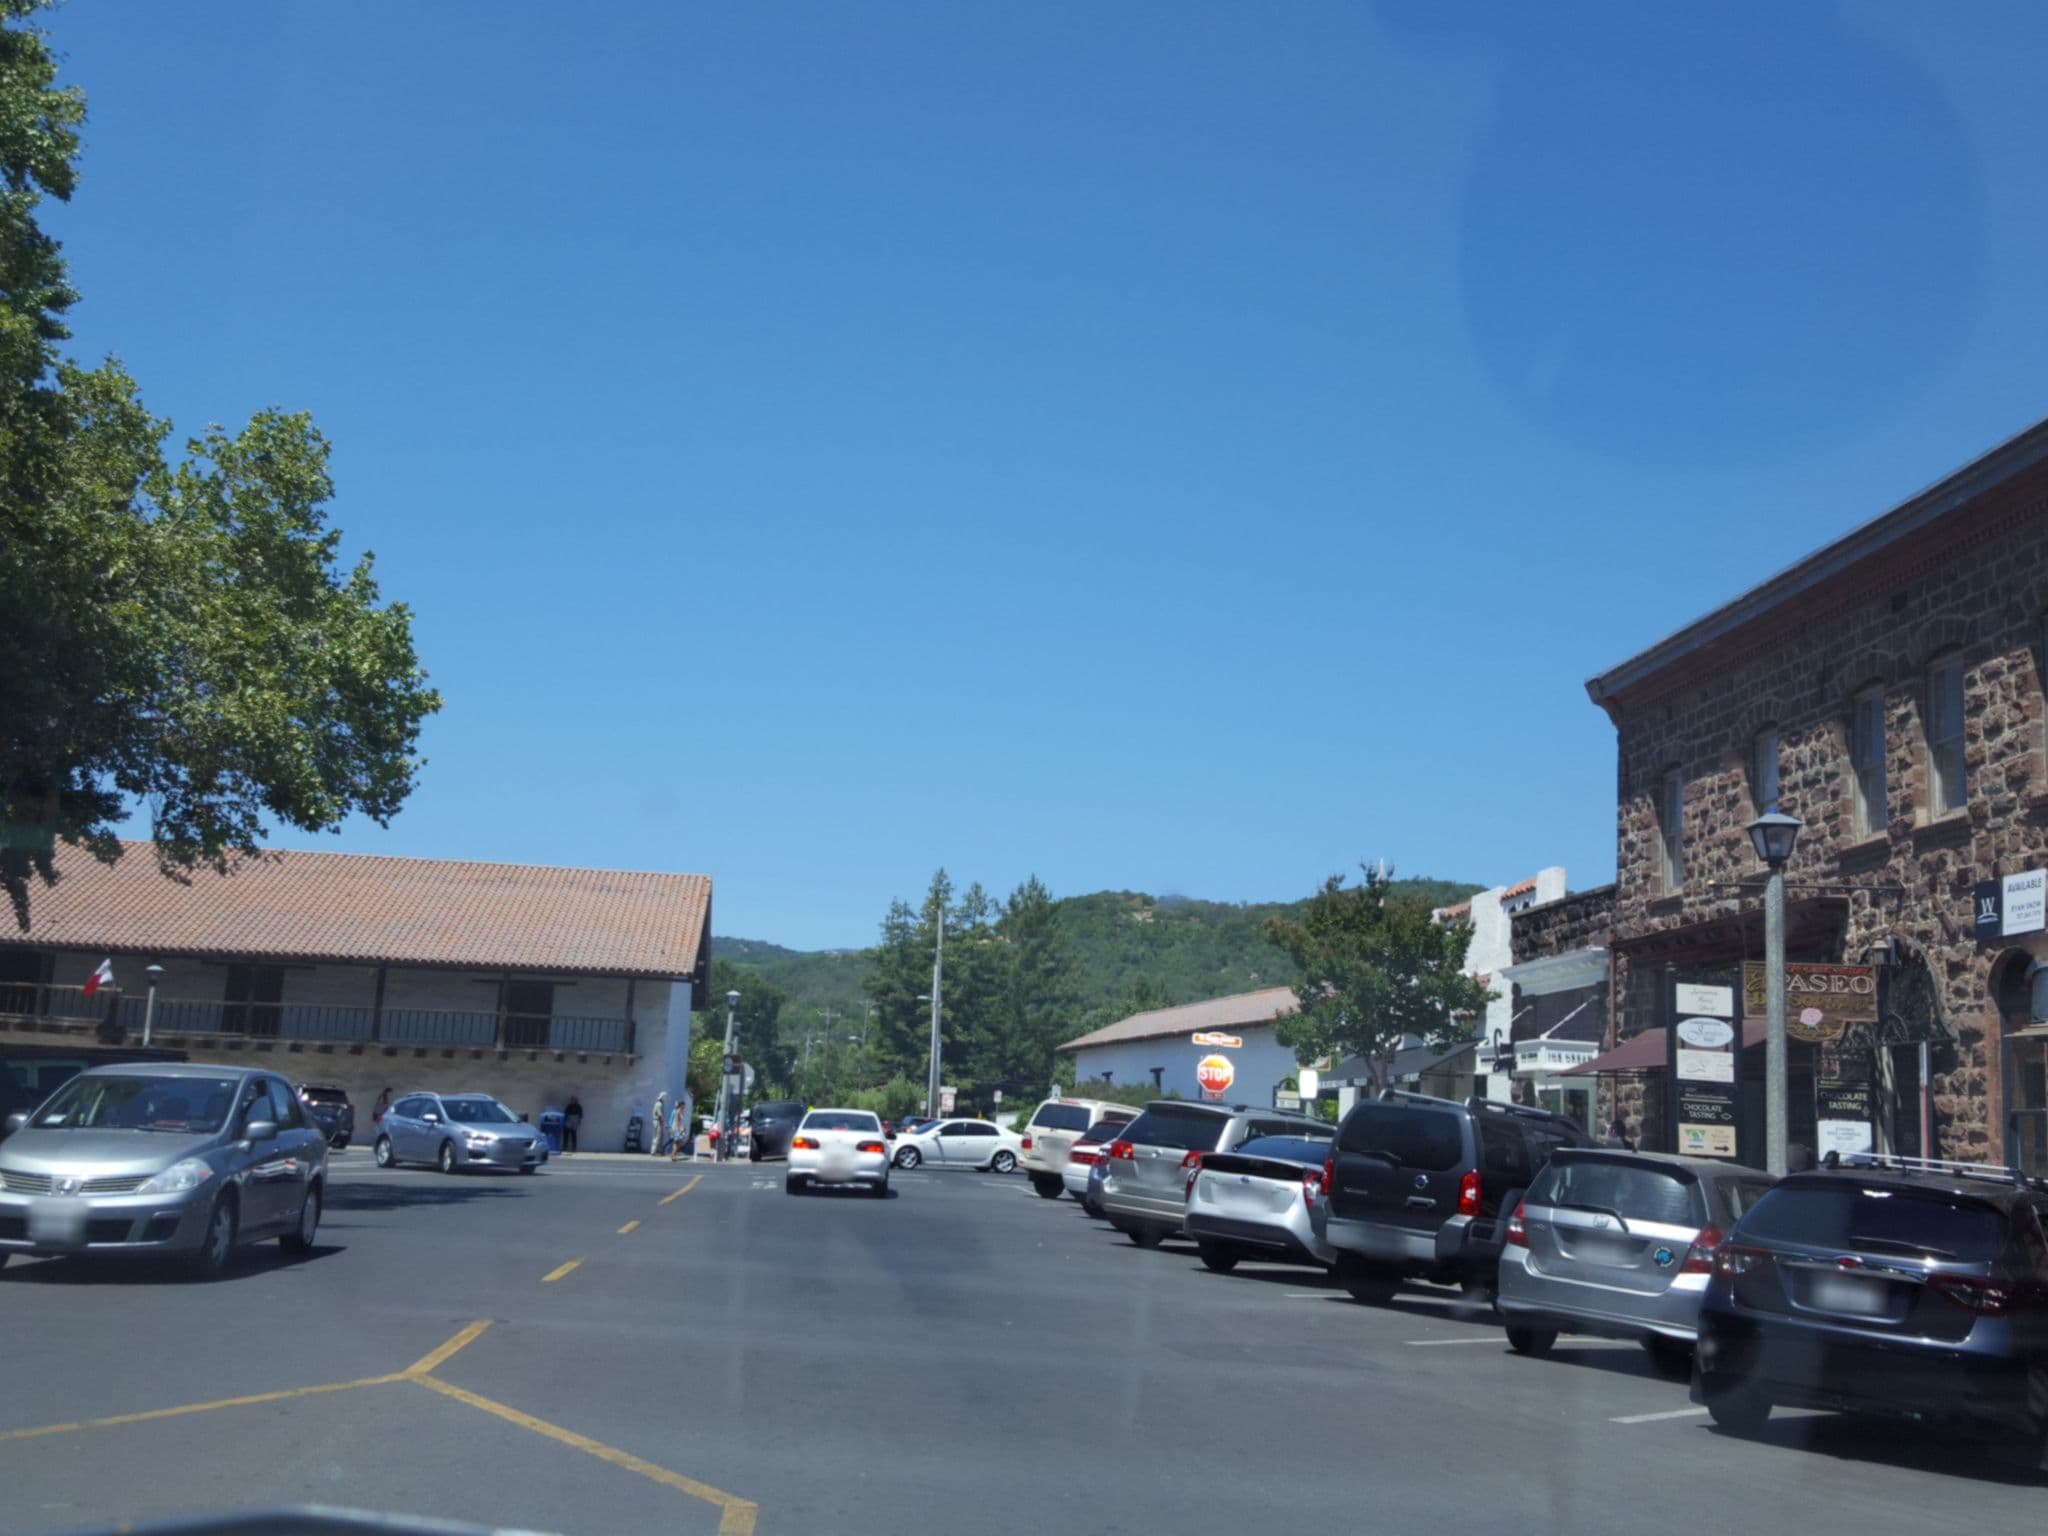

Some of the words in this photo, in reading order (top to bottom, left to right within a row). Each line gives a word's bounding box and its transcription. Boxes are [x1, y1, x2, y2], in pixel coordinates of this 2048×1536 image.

[2007, 877, 2042, 893] AVAILABLE
[1784, 973, 1874, 994] ASEO
[1199, 1066, 1231, 1082] STOP
[1683, 1103, 1722, 1112] CHOCOLATE
[1828, 1101, 1862, 1110] TASTING
[1689, 1110, 1717, 1119] TASTING
